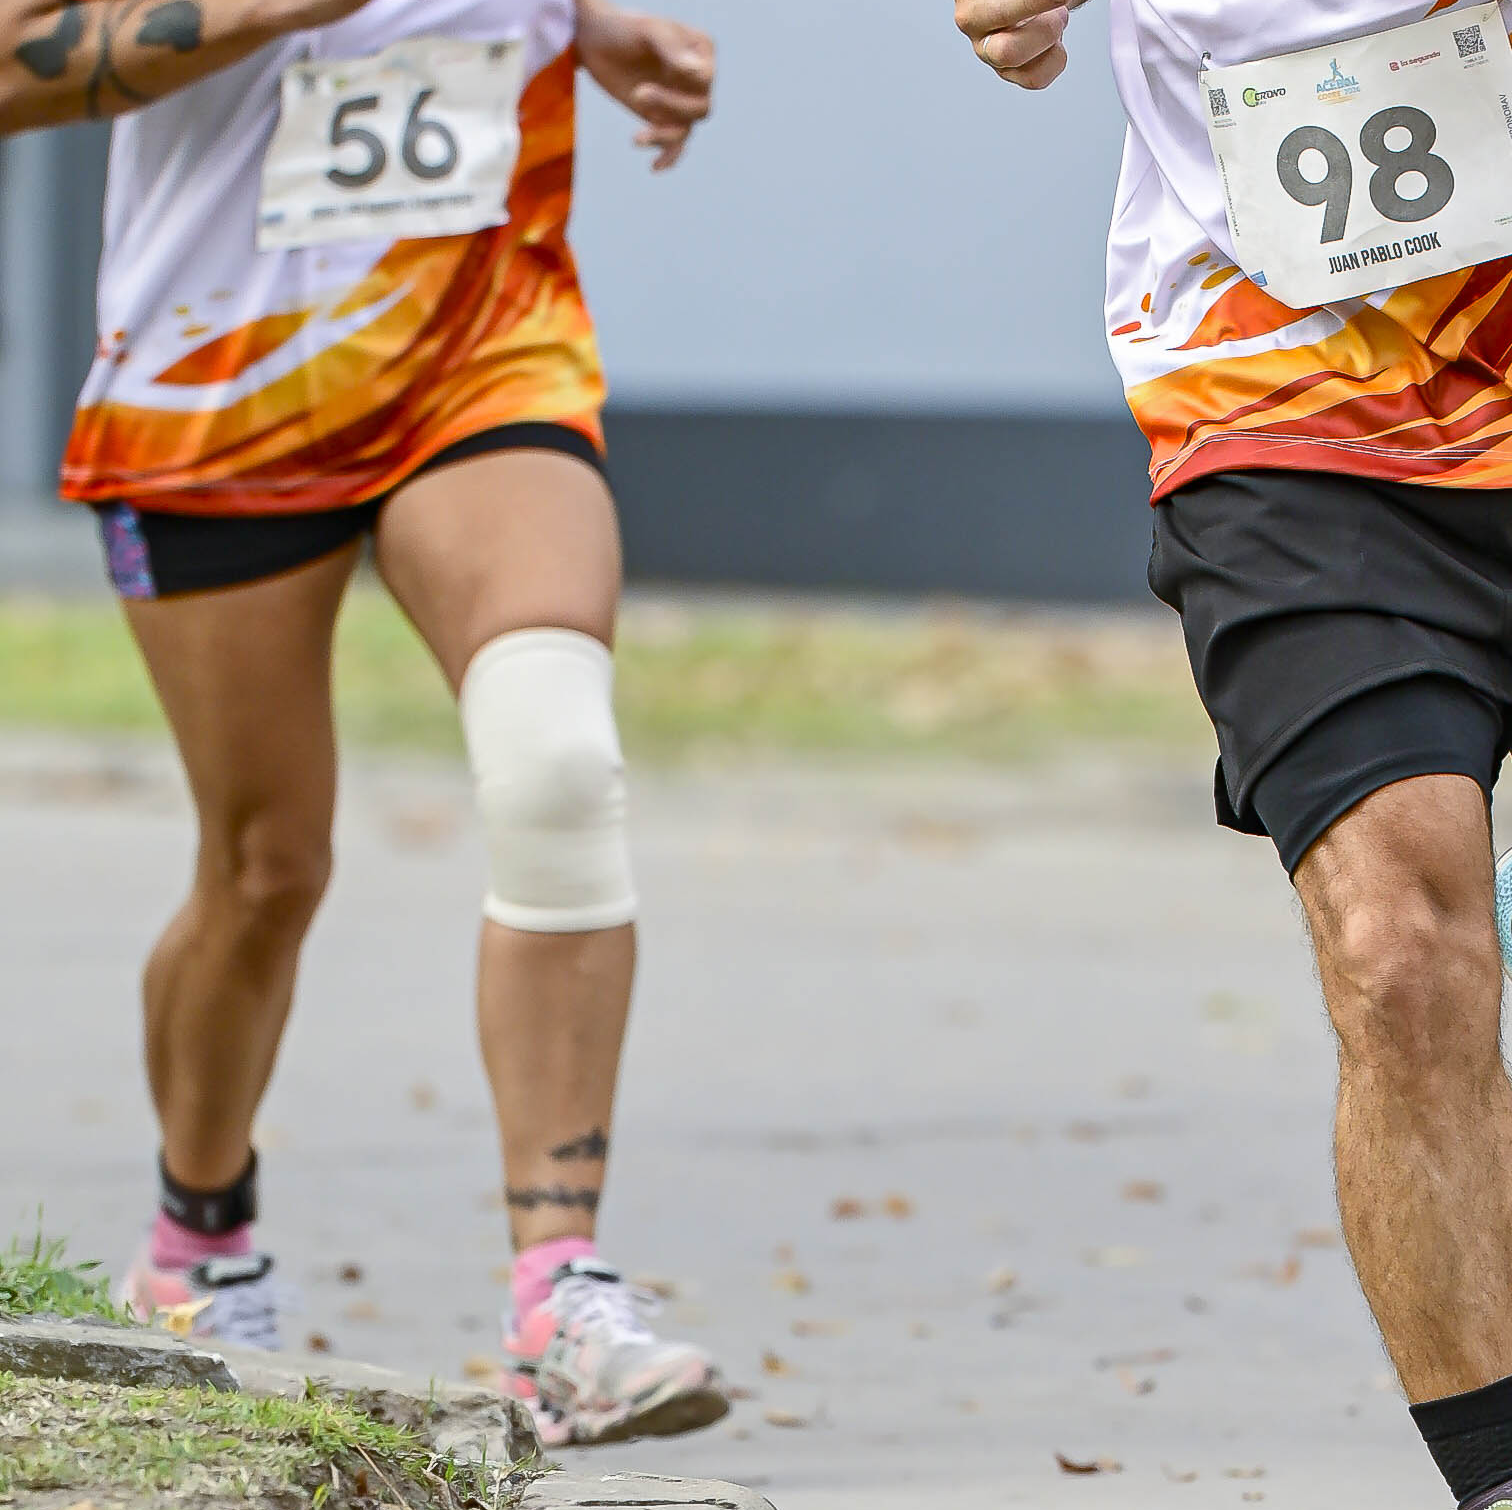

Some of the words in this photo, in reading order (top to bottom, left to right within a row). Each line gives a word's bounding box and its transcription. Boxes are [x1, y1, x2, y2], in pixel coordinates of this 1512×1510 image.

[326, 87, 458, 188] 56
[1276, 105, 1456, 244] 98
[1328, 252, 1360, 275] JUAN
[1360, 242, 1403, 267] PABLO
[1404, 231, 1442, 256] COOK
